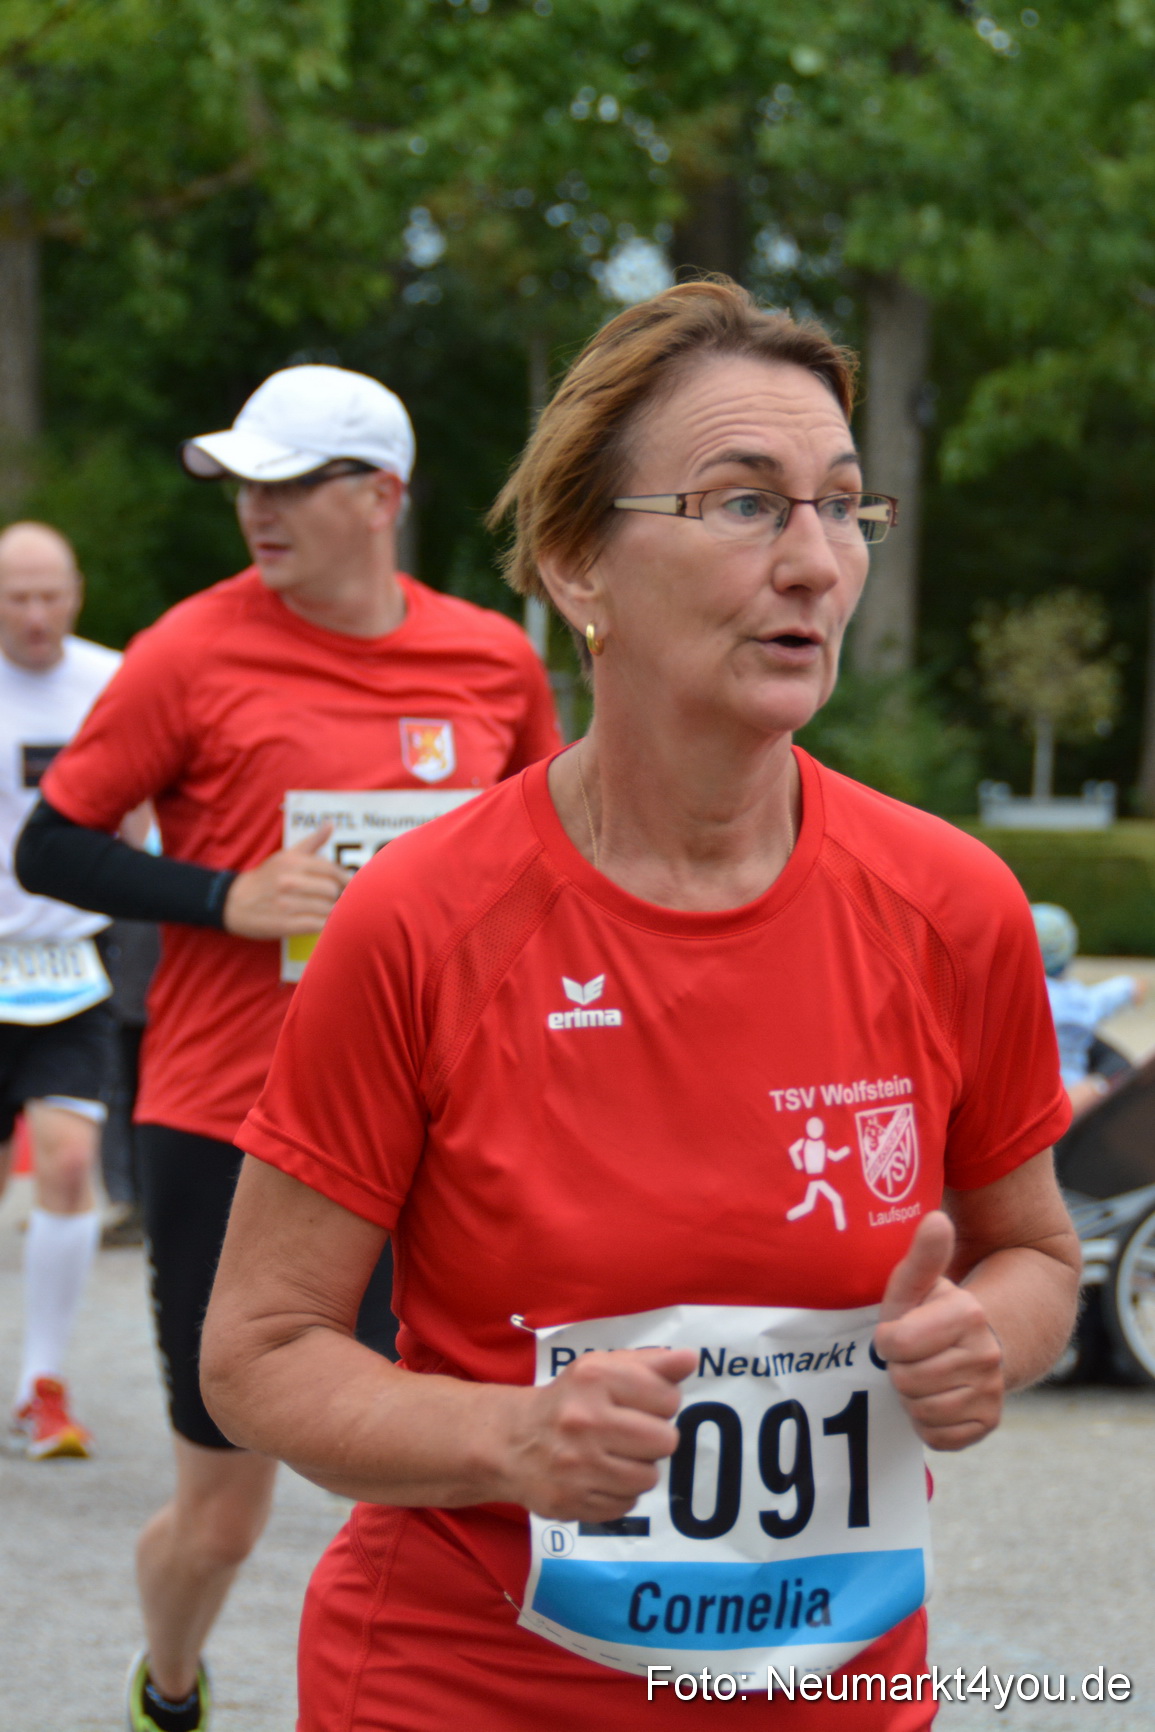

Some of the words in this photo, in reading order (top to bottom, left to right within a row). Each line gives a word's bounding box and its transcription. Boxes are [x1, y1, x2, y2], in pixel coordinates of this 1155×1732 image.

[548, 1008, 622, 1030] erima
[769, 1086, 816, 1112] TSV
[820, 1075, 913, 1107] Wolfstein
[868, 1202, 921, 1227] Laufsport
[697, 1341, 855, 1378] Neumarkt
[577, 1390, 870, 1541] 091
[551, 1529, 565, 1553] D
[627, 1578, 833, 1635] Cornelia
